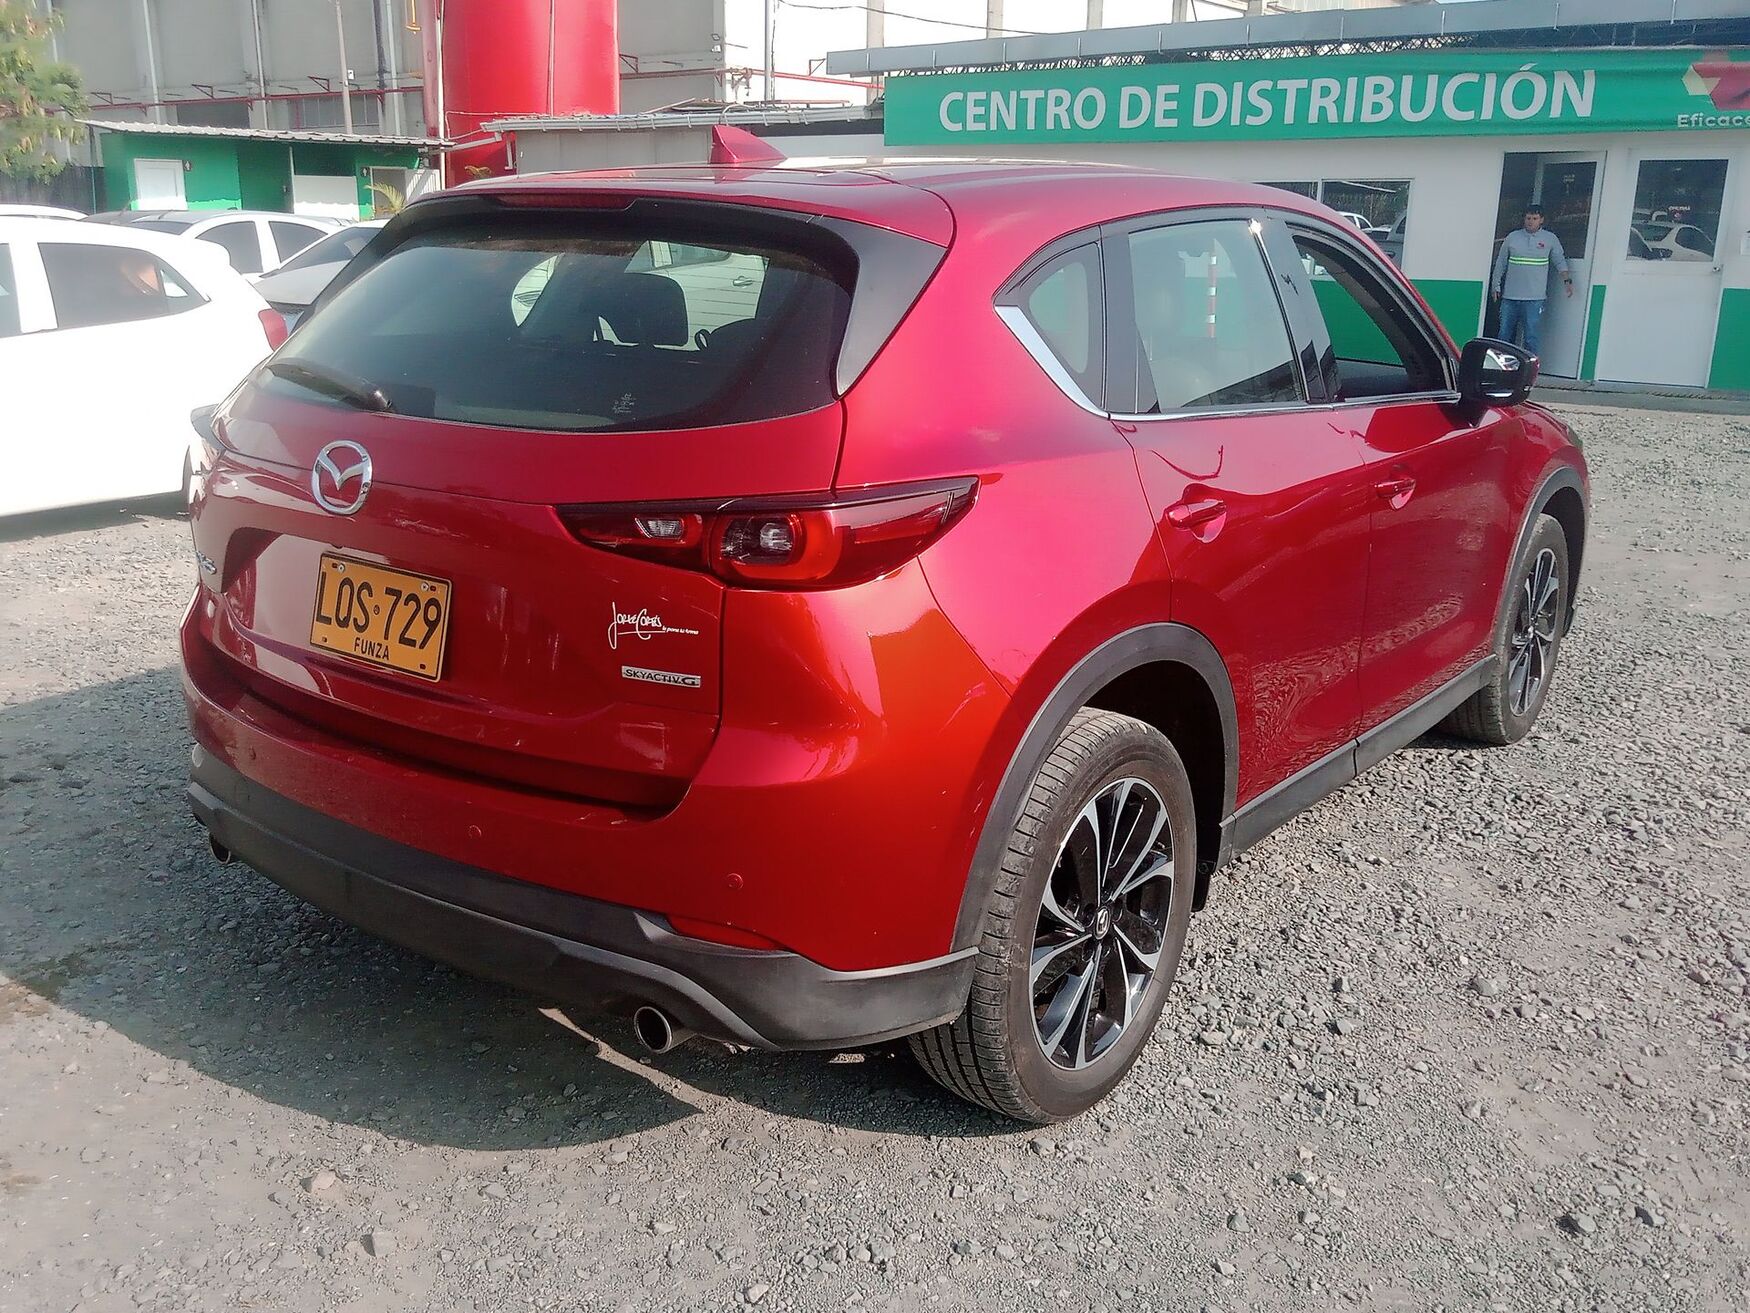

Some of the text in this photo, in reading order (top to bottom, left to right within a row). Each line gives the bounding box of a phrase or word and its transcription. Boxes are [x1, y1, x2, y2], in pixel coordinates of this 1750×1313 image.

[938, 63, 1596, 132] CENTRO DE DISTRIBUCIÓN
[354, 636, 390, 662] FUNZA
